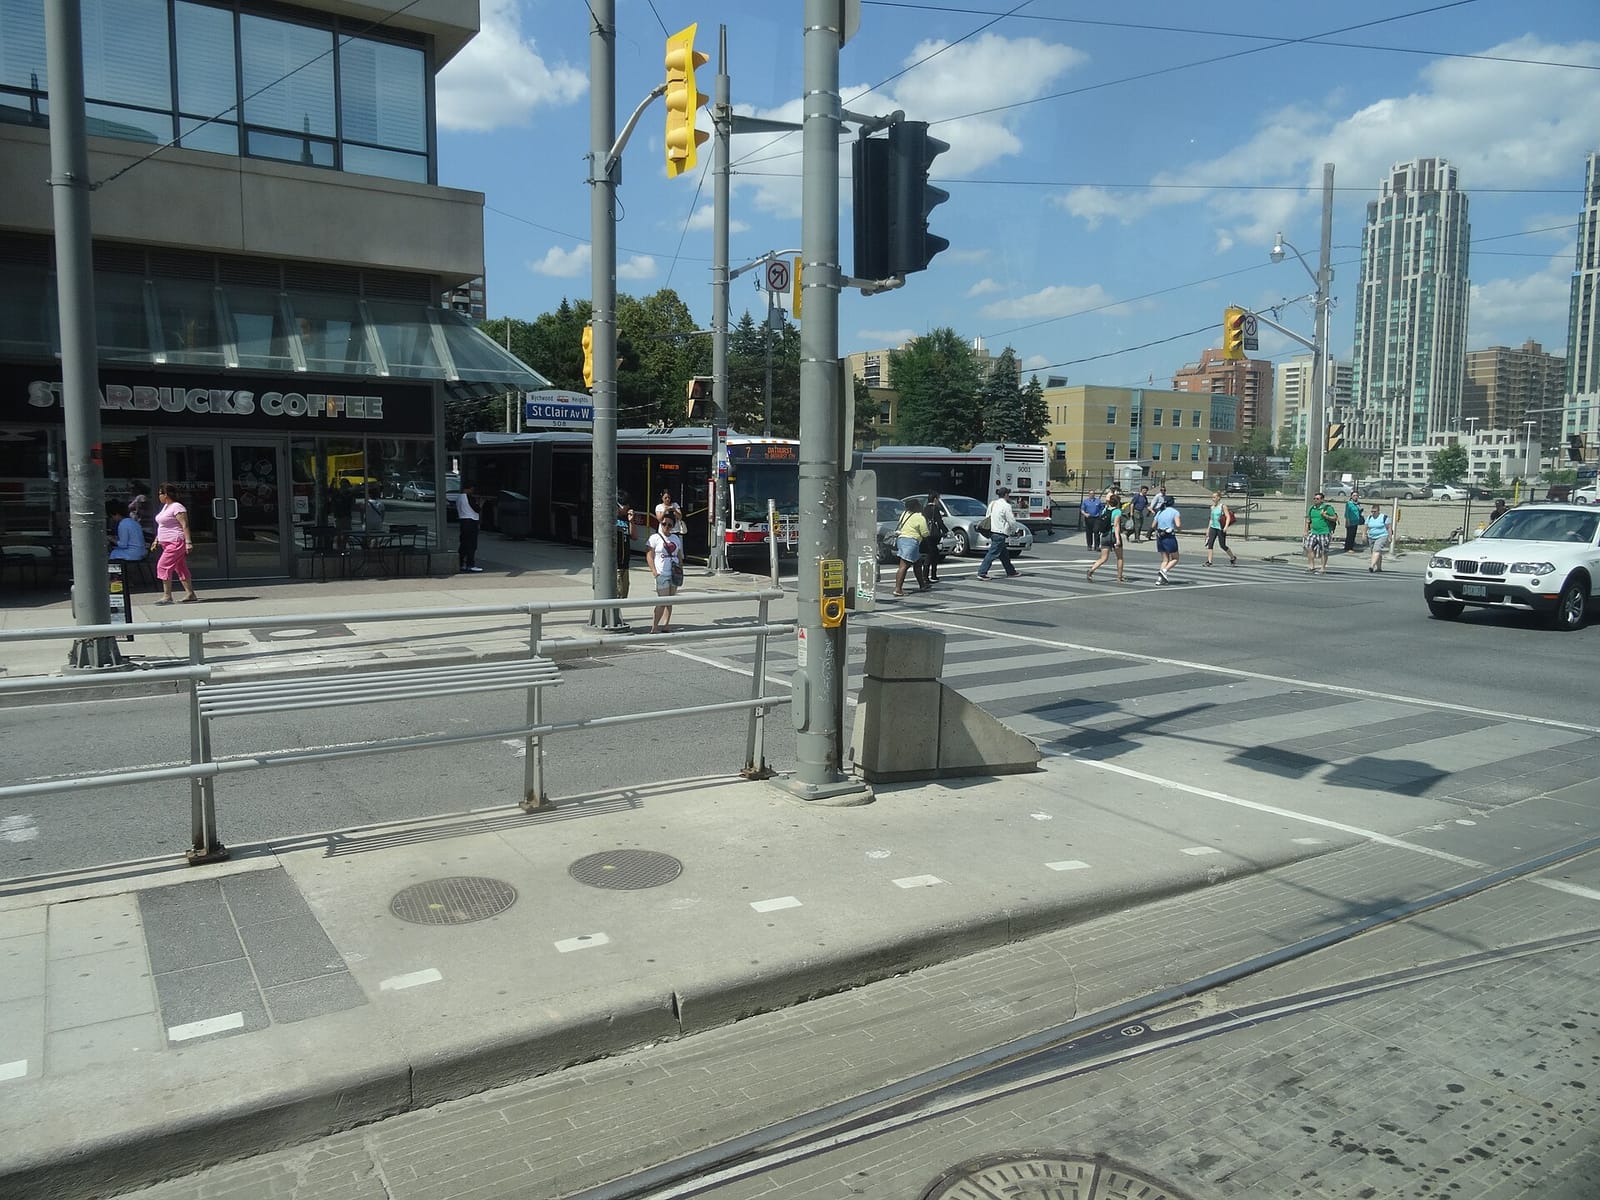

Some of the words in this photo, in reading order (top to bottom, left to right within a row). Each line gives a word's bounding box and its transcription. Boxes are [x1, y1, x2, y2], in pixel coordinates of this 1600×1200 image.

[28, 380, 254, 415] SRBUCKS
[261, 392, 383, 419] COFFEE
[532, 405, 542, 417] St
[545, 406, 568, 418] Clair
[570, 409, 580, 418] Av
[581, 408, 590, 419] W
[745, 446, 751, 459] 7
